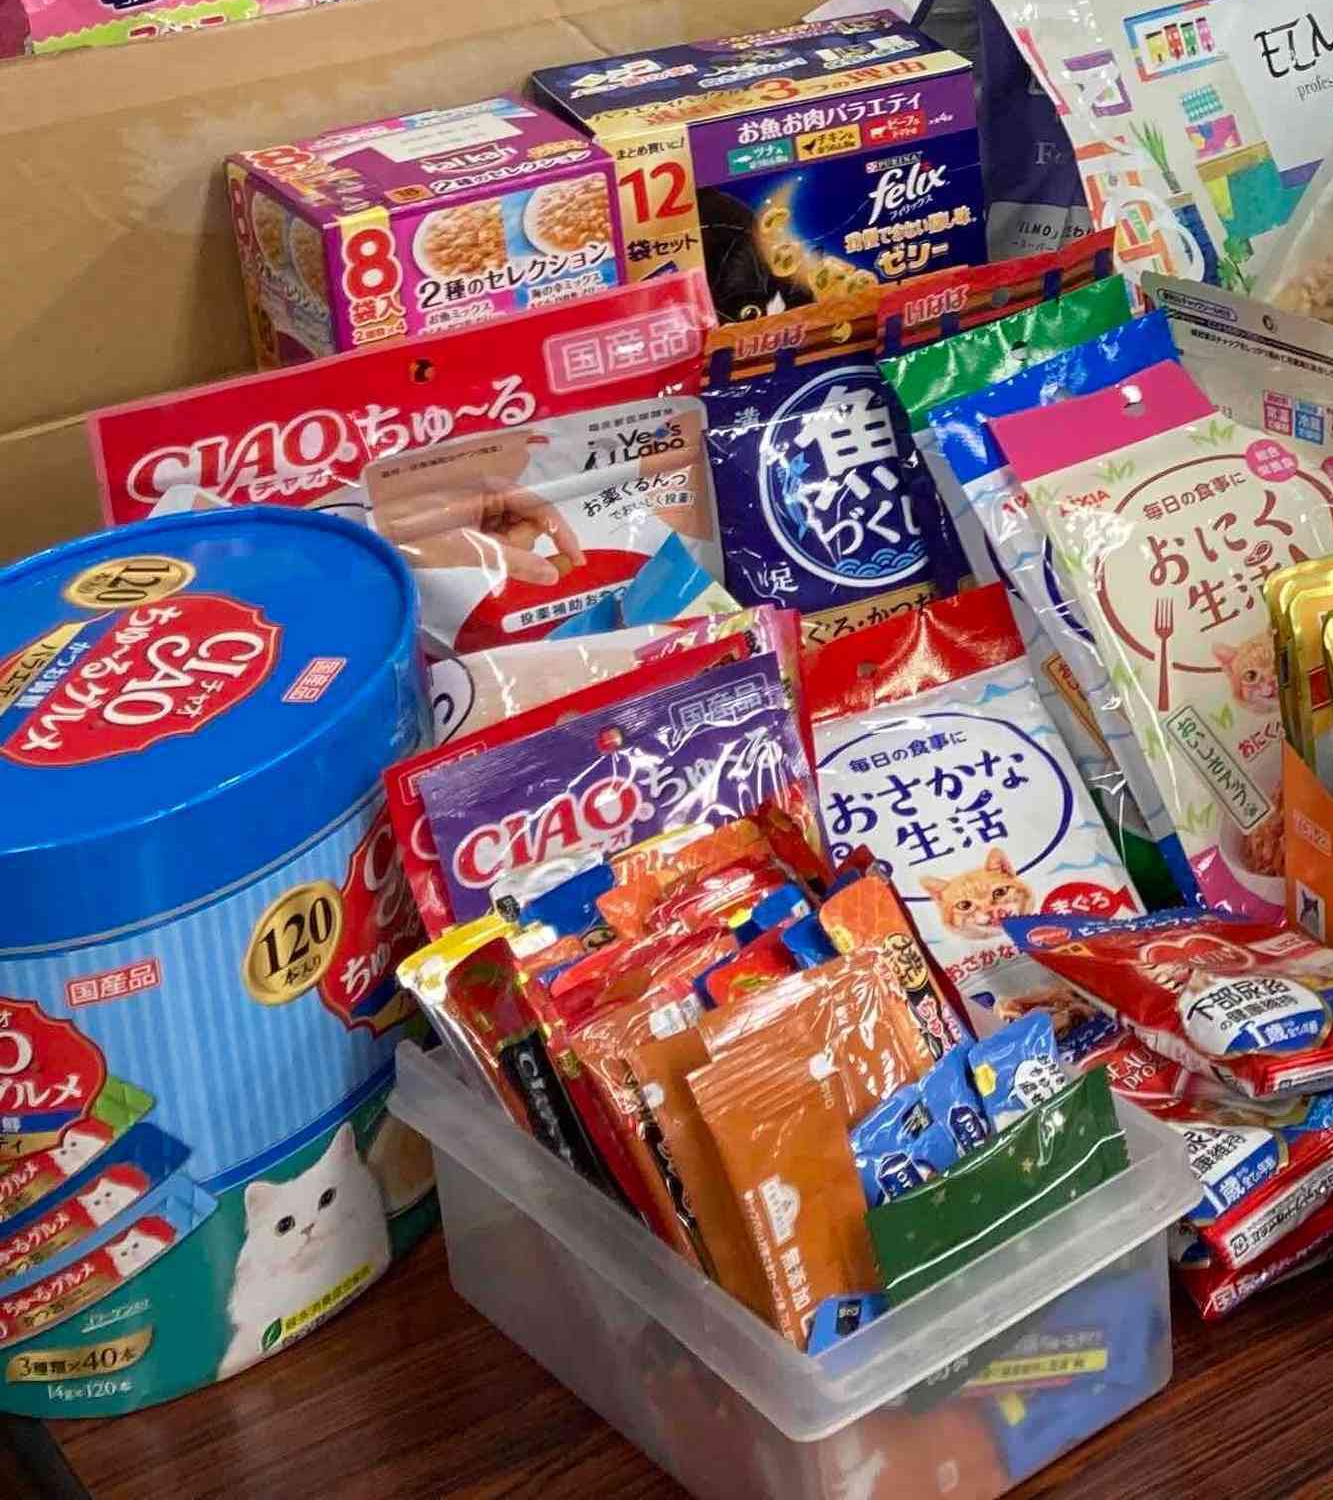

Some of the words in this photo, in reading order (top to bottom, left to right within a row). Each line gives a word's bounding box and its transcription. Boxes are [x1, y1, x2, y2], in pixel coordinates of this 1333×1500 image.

[736, 92, 922, 146] お魚お肉バラエティ
[619, 160, 694, 226] 12
[868, 162, 947, 226] felix
[345, 228, 402, 300] 8
[626, 233, 700, 263] 袋セット
[876, 241, 950, 278] ゼリー
[418, 242, 609, 311] 2種のセレクション
[903, 284, 969, 327] いなば
[560, 315, 695, 380] 国産品
[734, 323, 806, 358] いなば
[125, 409, 350, 505] CIAO
[623, 438, 685, 463] Labo
[1142, 470, 1247, 522] 毎日の食事に
[1144, 489, 1294, 586] おにく
[96, 563, 171, 603] 120
[848, 729, 969, 774] 毎日の食事に
[826, 749, 1030, 835] おさかな
[453, 776, 643, 889] CIAO
[894, 807, 1009, 866] 生活
[1047, 885, 1109, 918] まぐろ
[257, 896, 337, 977] 120
[68, 963, 158, 1005] 国産品
